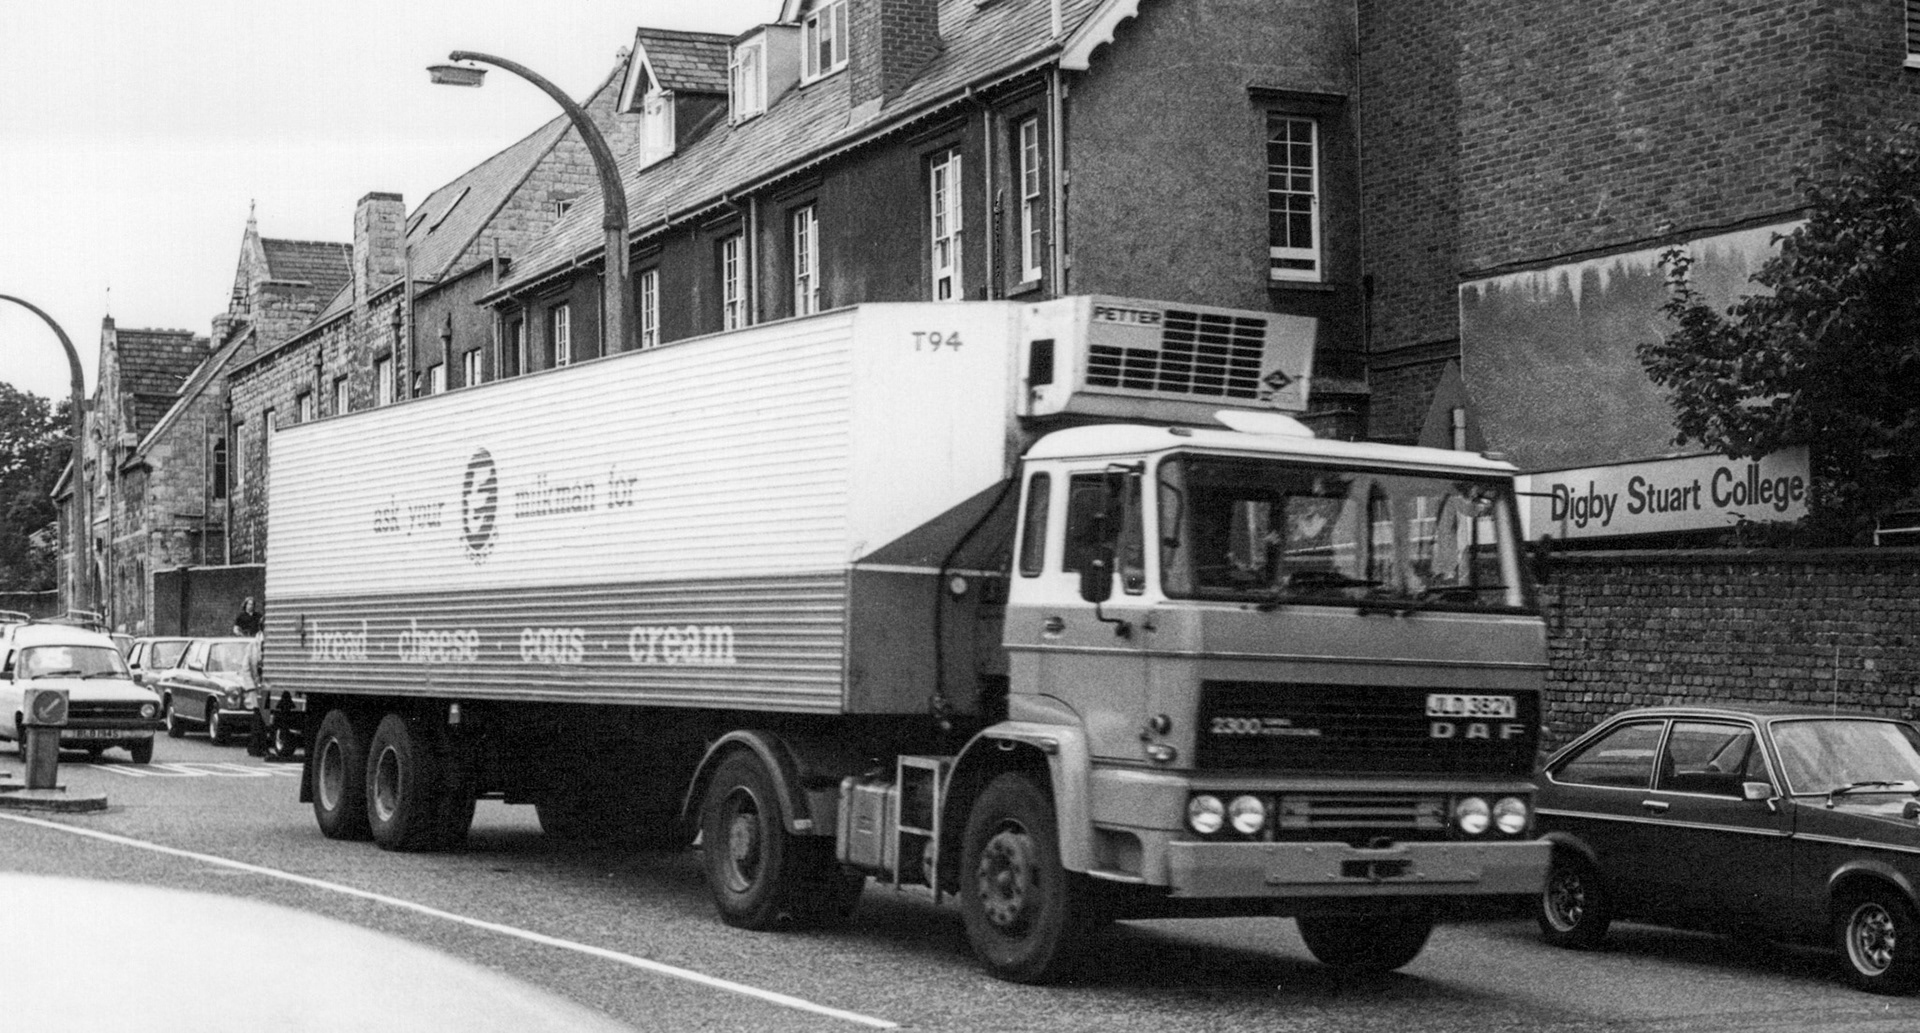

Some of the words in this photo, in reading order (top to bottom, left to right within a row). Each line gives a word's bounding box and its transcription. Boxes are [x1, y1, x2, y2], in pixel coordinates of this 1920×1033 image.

[1094, 306, 1161, 324] PETTER
[911, 331, 963, 352] T94
[374, 493, 400, 534] ask
[408, 501, 445, 537] your
[515, 472, 596, 519] milkman
[608, 463, 638, 509] for
[1551, 481, 1618, 528] Digby
[1627, 476, 1701, 515] Stuart
[1711, 463, 1805, 513] College
[312, 619, 369, 662] bread
[398, 617, 479, 663] cheese
[629, 625, 737, 665] cream
[1211, 717, 1260, 735] 2300
[1430, 722, 1526, 739] DAF
